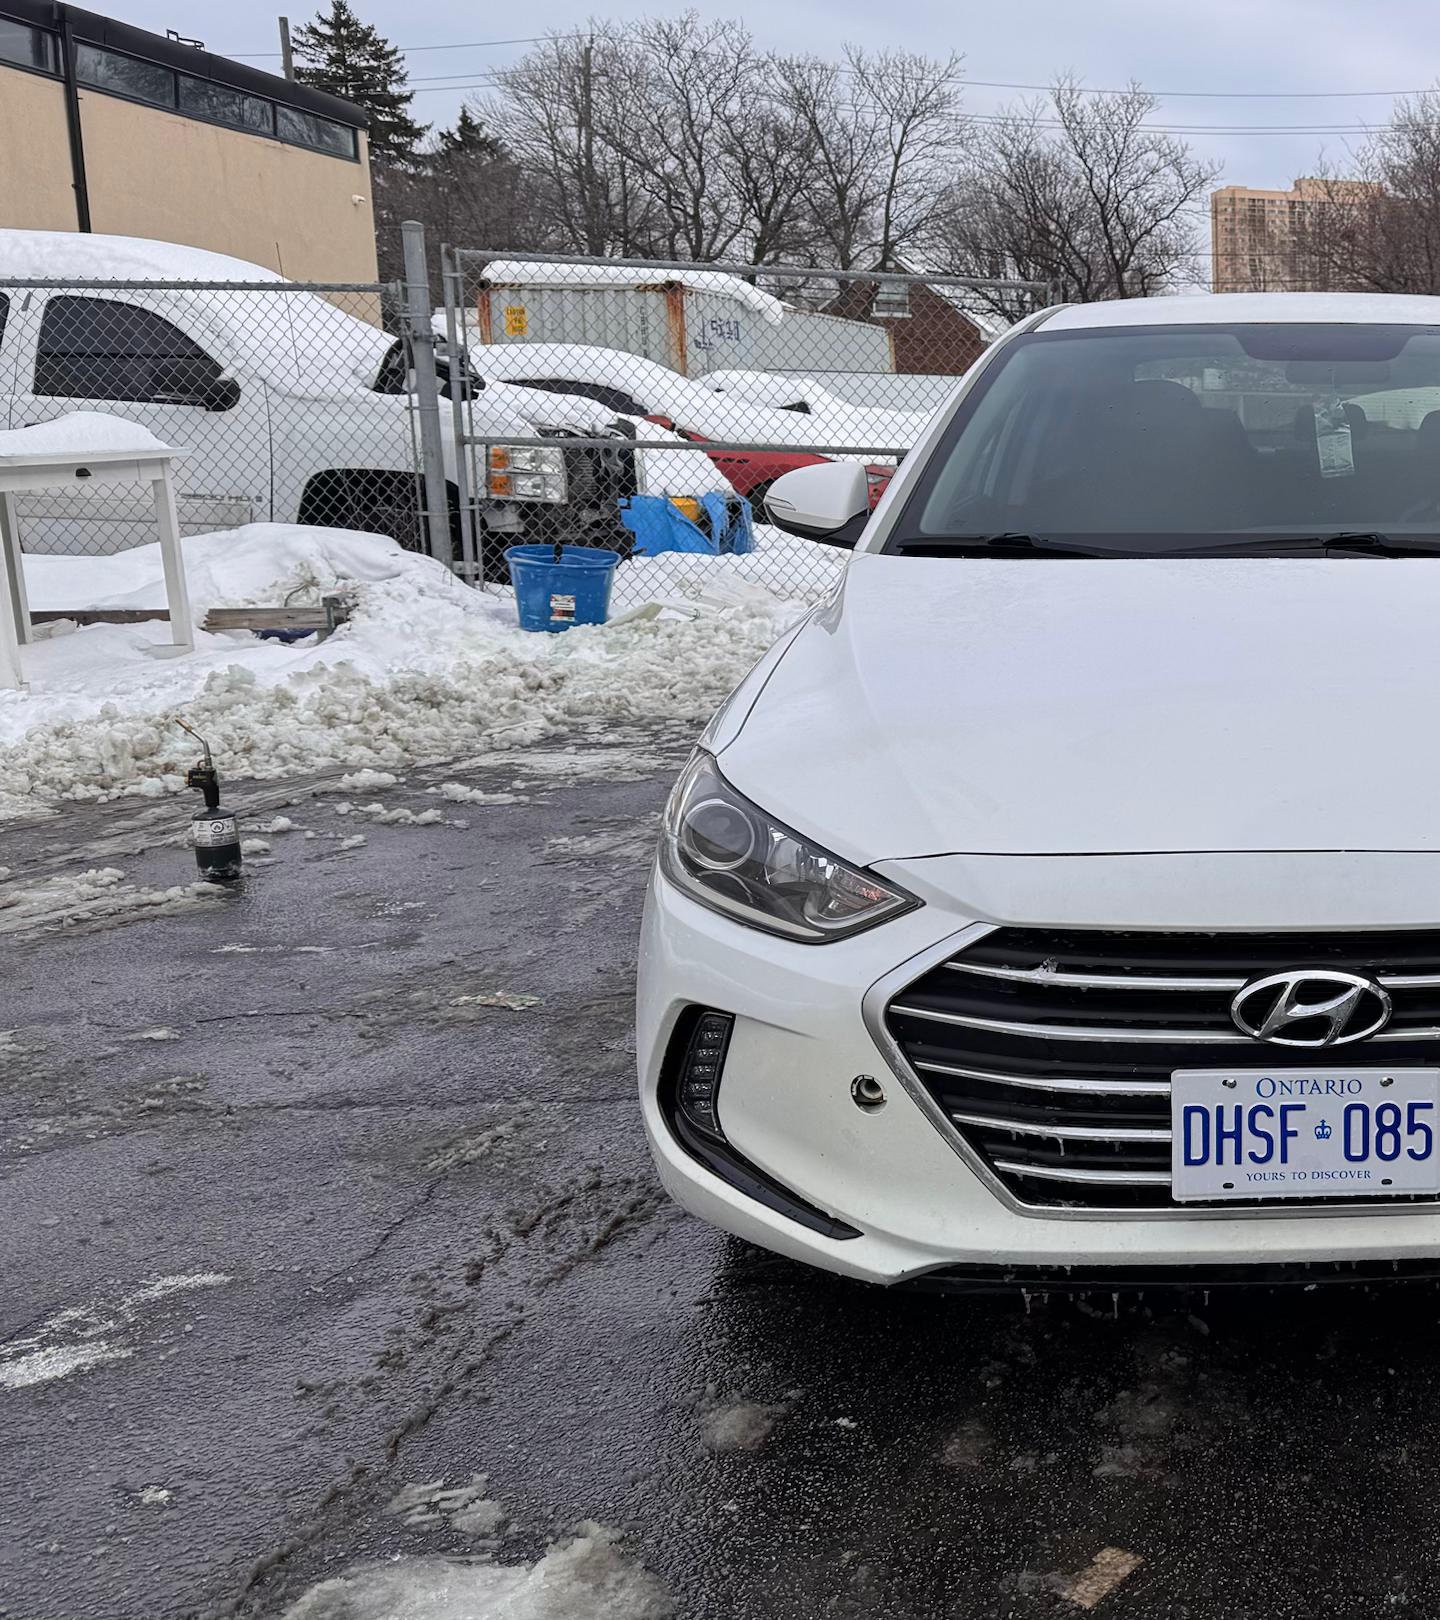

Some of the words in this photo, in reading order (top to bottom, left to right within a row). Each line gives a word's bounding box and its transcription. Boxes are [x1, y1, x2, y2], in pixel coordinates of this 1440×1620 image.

[1256, 1077, 1362, 1098] ONTARIO
[1183, 1104, 1306, 1166] DHSF
[1344, 1102, 1434, 1162] 085
[1246, 1172, 1286, 1182] YOURS
[1292, 1172, 1306, 1180] TO
[1311, 1170, 1371, 1180] DISCOVER
